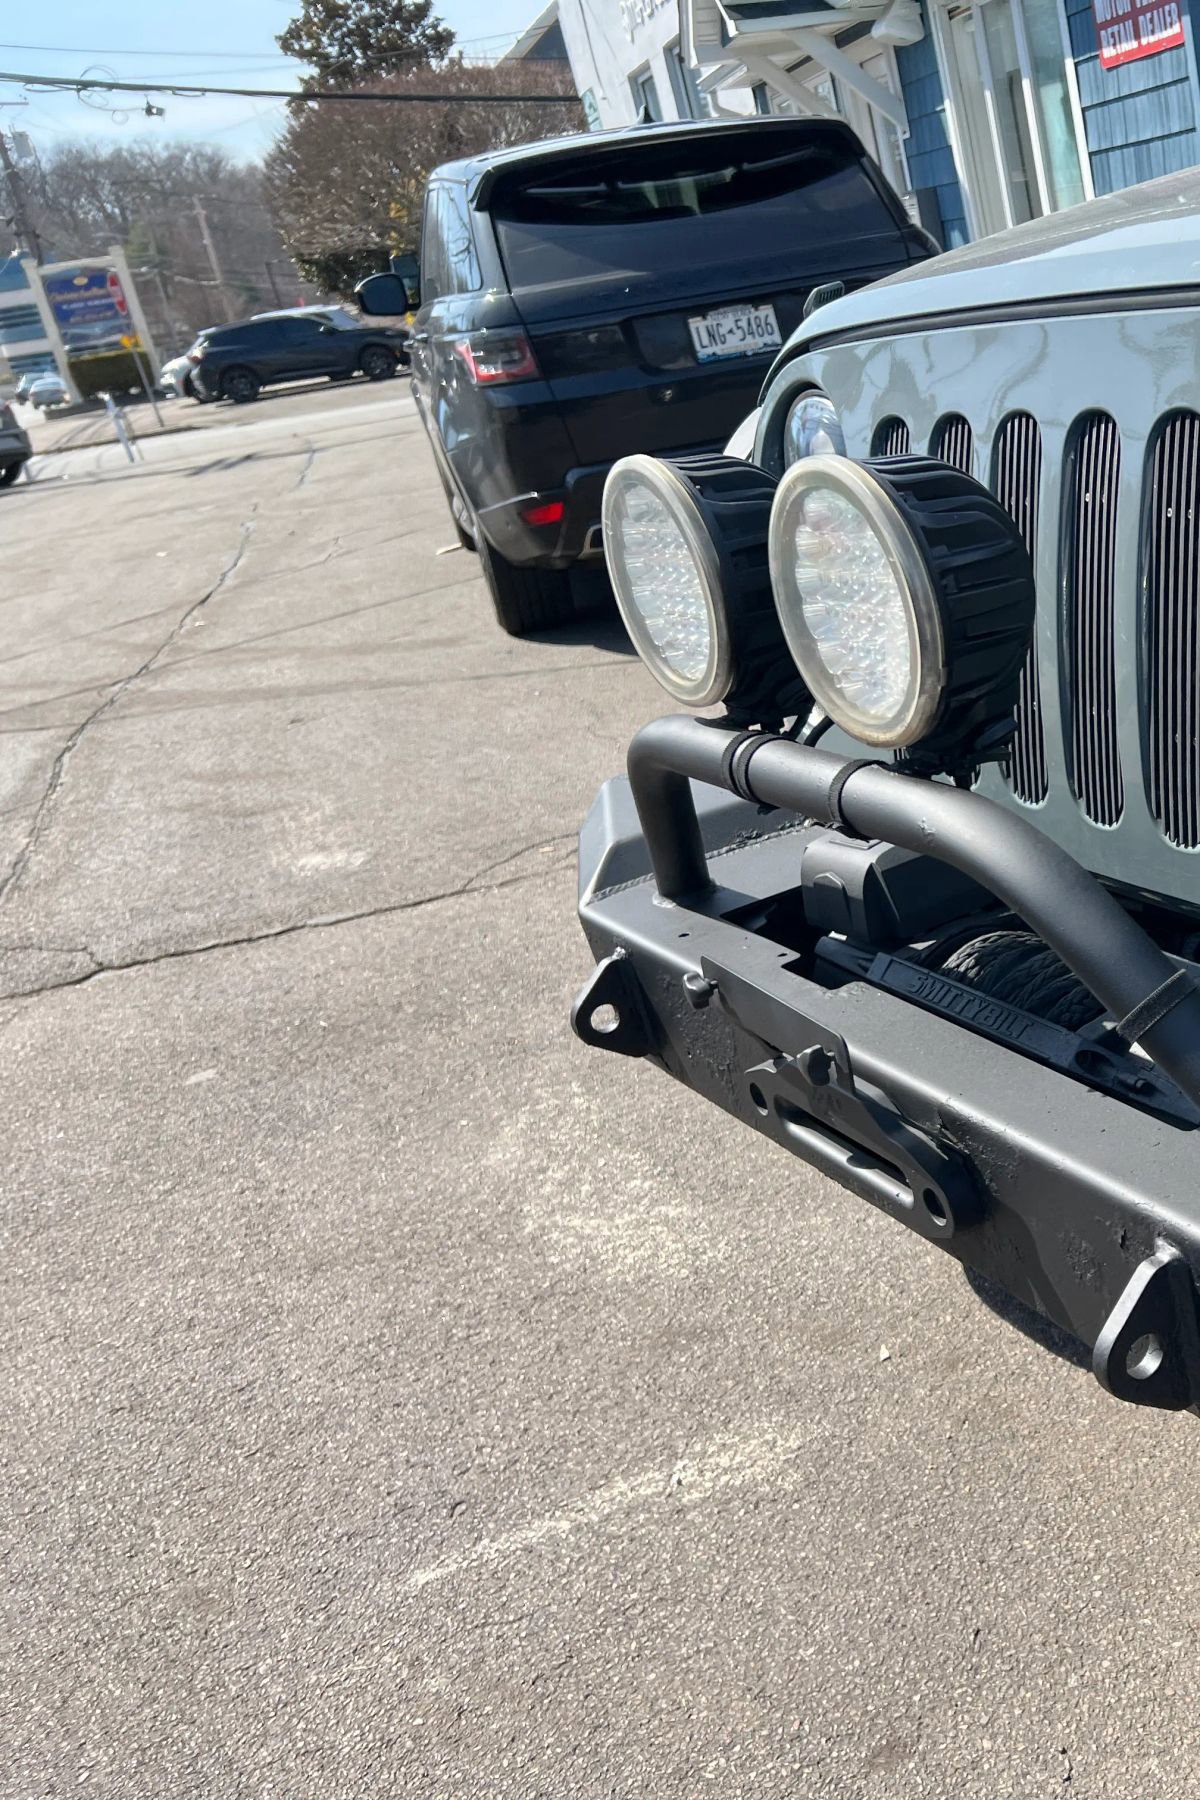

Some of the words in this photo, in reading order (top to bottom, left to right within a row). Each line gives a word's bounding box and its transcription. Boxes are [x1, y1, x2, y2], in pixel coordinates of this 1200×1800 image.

[1100, 20, 1138, 58] RETAIL
[1138, 3, 1181, 46] DEALER
[908, 975, 1034, 1040] SMITTYBILT
